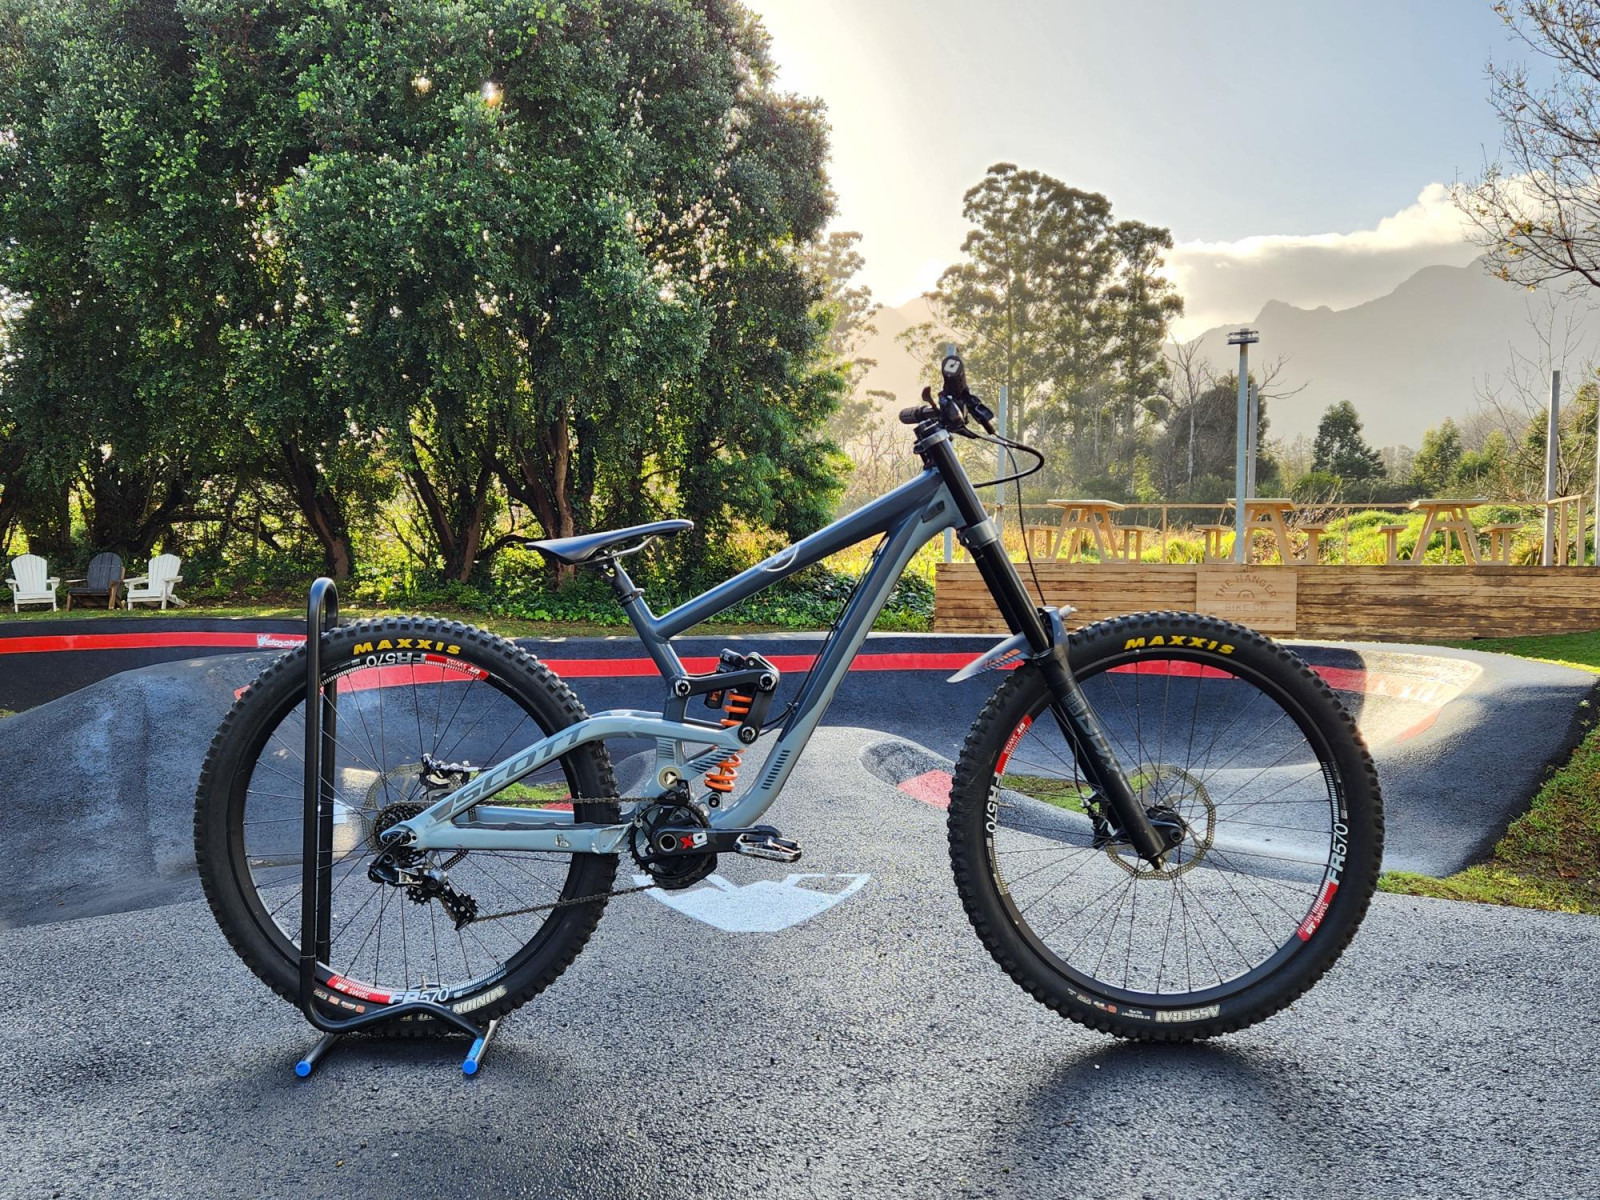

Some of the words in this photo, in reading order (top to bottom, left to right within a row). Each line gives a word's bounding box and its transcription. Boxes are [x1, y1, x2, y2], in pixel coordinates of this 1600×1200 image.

[1216, 579, 1234, 597] THE
[1235, 574, 1277, 598] HANGER
[353, 638, 462, 655] MAXXIS
[1124, 635, 1235, 655] MAXXIS
[366, 652, 427, 668] FR570
[453, 723, 590, 812] SCOTT
[986, 772, 1003, 834] FR570
[1306, 923, 1317, 936] DT
[1314, 901, 1330, 925] SWISS
[1325, 823, 1349, 884] FR570
[334, 982, 349, 992] DT
[388, 988, 450, 1005] FR570
[452, 984, 508, 1015] MINION
[1154, 1004, 1221, 1023] ASSEGAI
